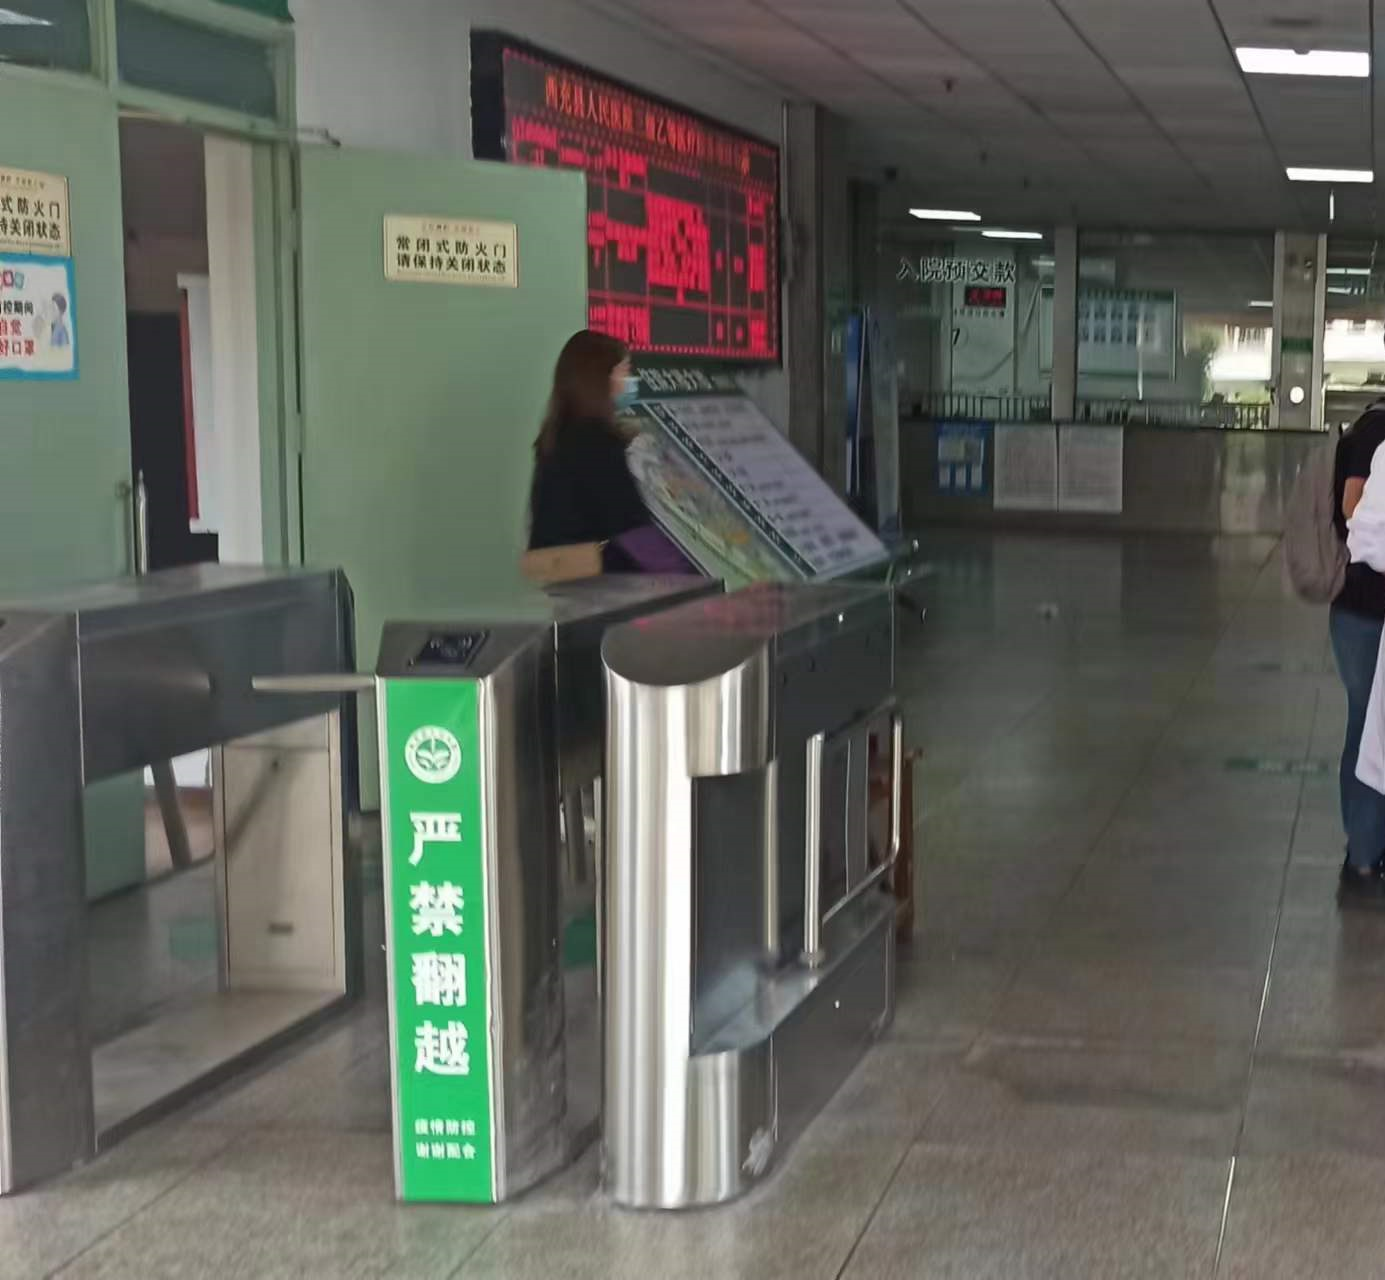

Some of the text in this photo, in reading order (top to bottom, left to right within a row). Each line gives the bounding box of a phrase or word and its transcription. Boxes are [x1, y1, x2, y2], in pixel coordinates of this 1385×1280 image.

[396, 235, 507, 259] 常闭式防火门
[397, 253, 507, 274] 请保持关闭状态
[897, 257, 1016, 283] 入院预交款
[0, 300, 34, 318] 控期间
[408, 811, 471, 1076] 严禁翻越
[415, 1141, 477, 1160] 谢谢配合
